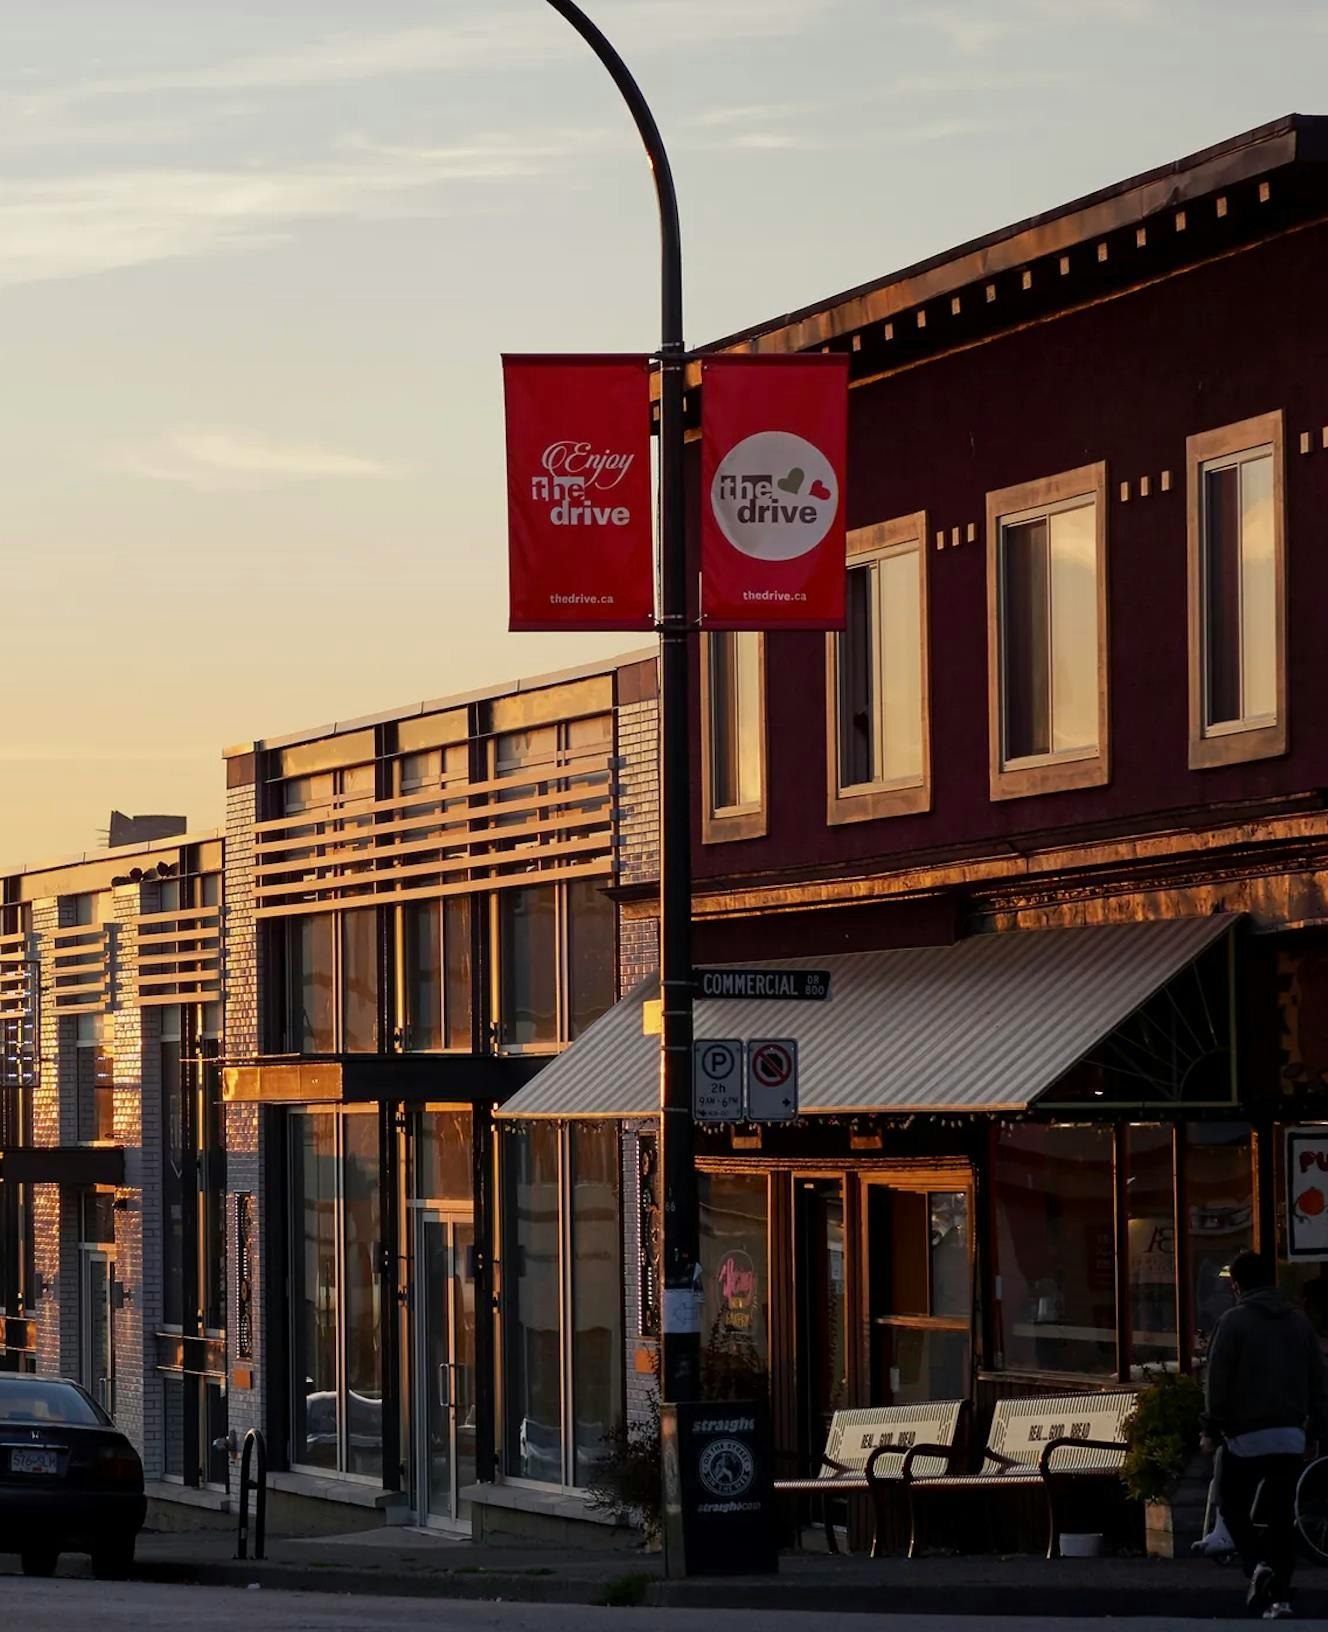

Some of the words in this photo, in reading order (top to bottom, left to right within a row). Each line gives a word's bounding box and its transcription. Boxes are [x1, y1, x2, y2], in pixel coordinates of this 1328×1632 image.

[542, 441, 634, 490] Enjoy
[532, 477, 585, 501] the
[720, 475, 772, 500] the
[550, 500, 630, 526] drive
[737, 499, 817, 524] drive
[550, 594, 614, 604] thedrive.ca
[743, 590, 807, 601] thedrive.ca
[703, 973, 798, 996] COMMERCIAL
[807, 975, 819, 985] DR
[805, 985, 825, 996] 800
[712, 1052, 726, 1072] P
[711, 1083, 726, 1093] 2h
[710, 1443, 724, 1453] THE
